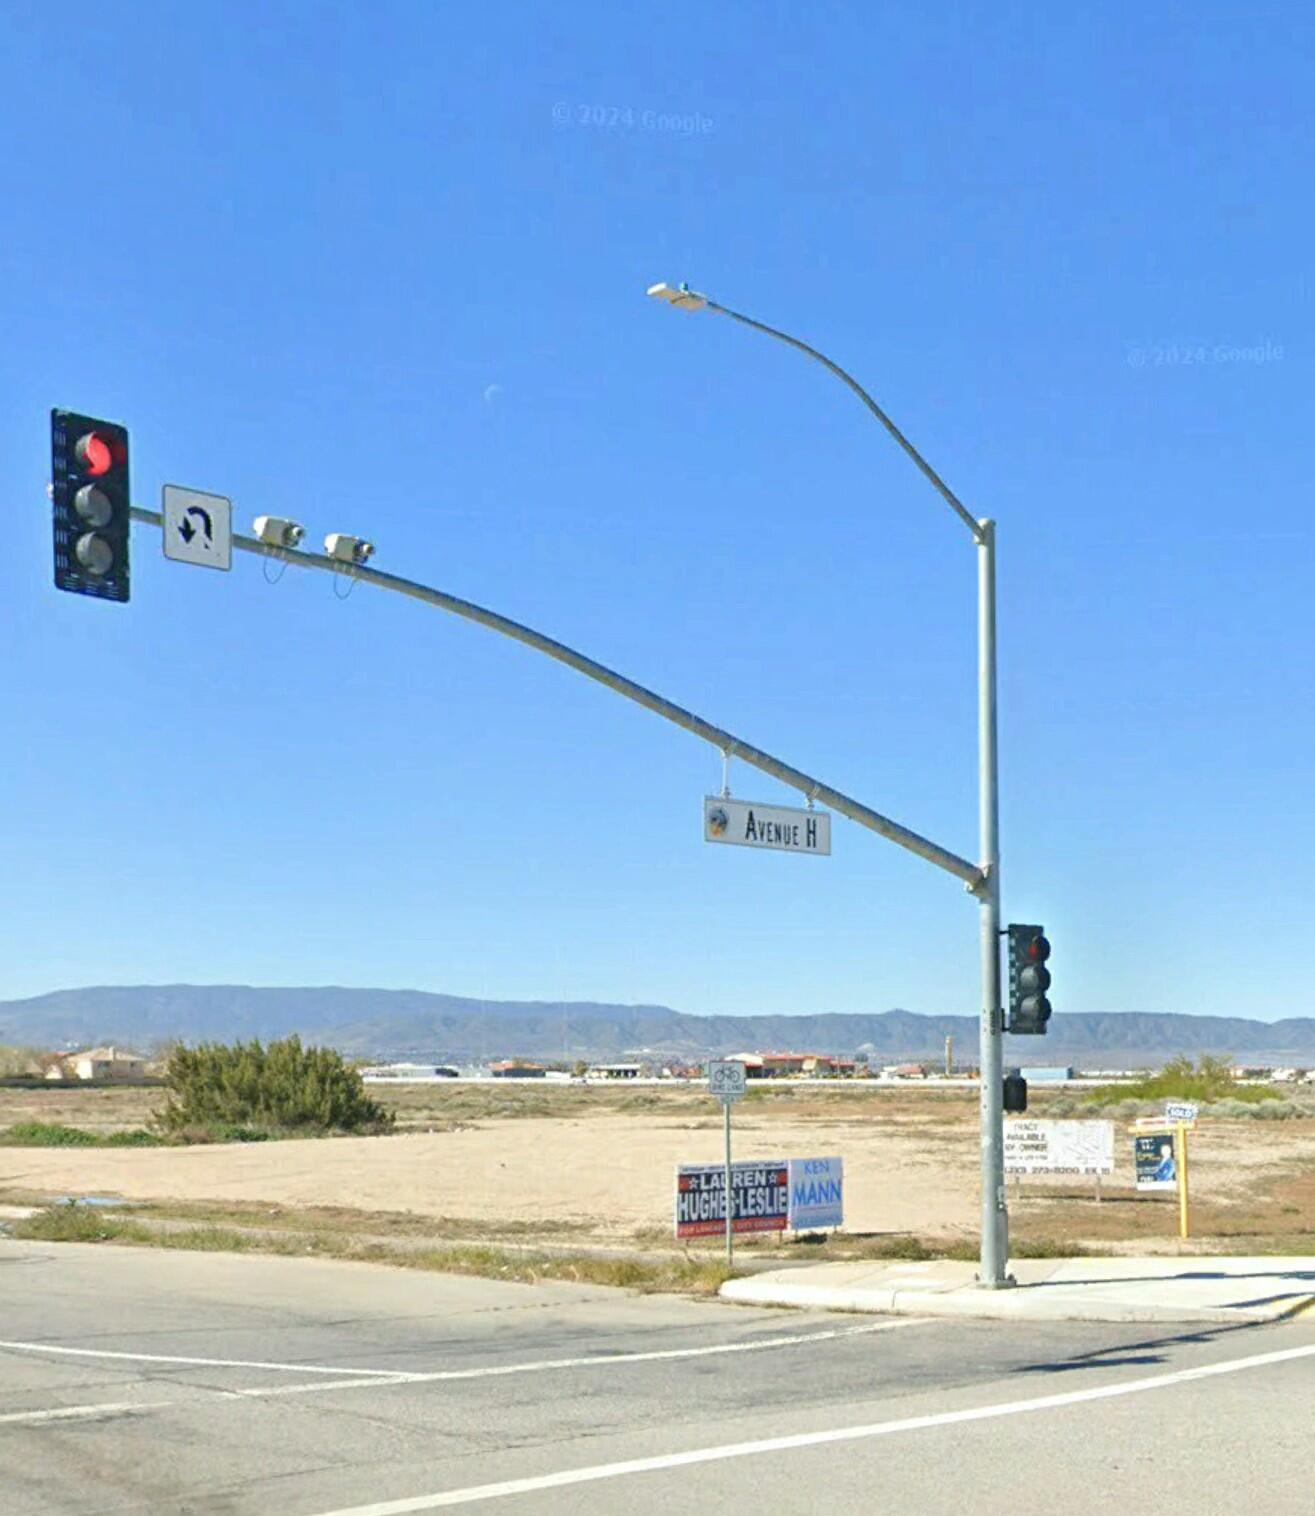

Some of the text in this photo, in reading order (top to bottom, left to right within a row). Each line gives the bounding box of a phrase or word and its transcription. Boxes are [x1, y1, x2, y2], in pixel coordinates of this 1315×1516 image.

[806, 817, 817, 848] H
[804, 1159, 830, 1175] KEN
[793, 1179, 841, 1207] MANN
